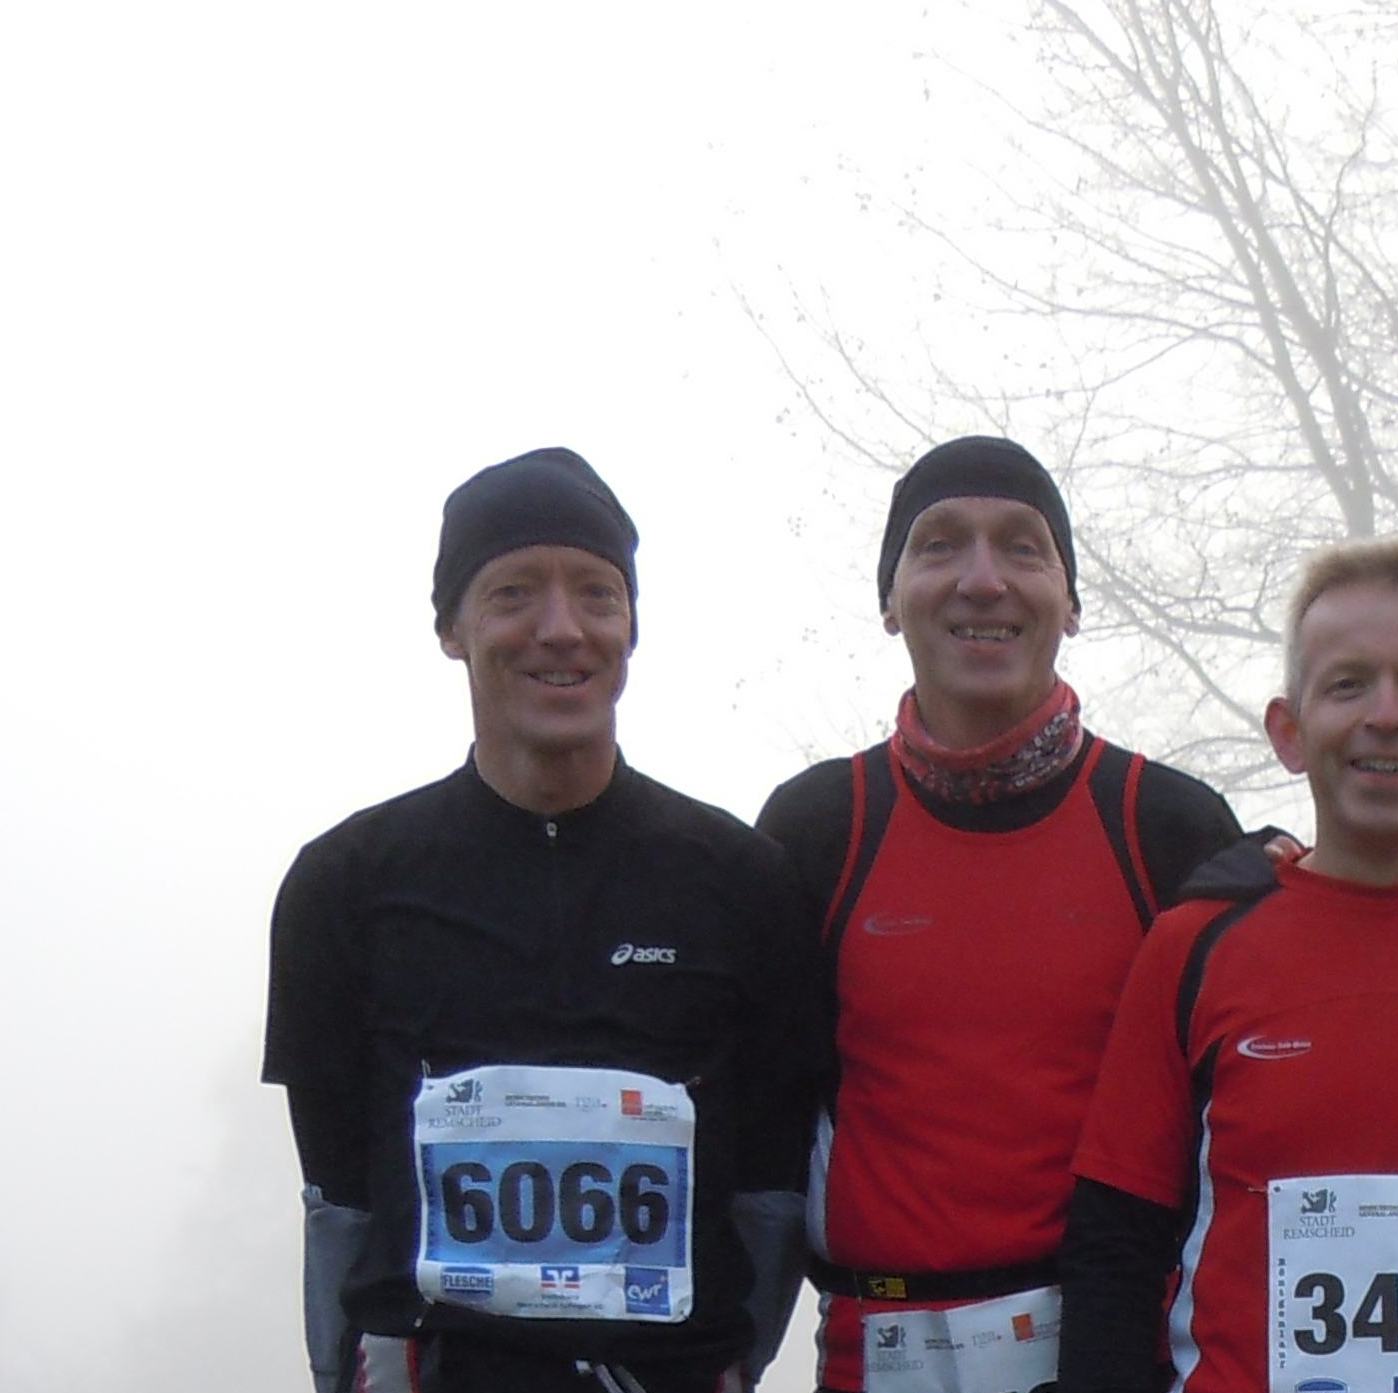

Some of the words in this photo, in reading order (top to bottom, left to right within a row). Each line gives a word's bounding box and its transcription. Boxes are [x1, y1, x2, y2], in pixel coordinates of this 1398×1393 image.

[632, 947, 677, 964] asics
[441, 1161, 670, 1245] 6066
[1299, 1215, 1336, 1227] STADT
[1283, 1227, 1356, 1240] REMSCHEID
[443, 1274, 492, 1290] FLESCHE
